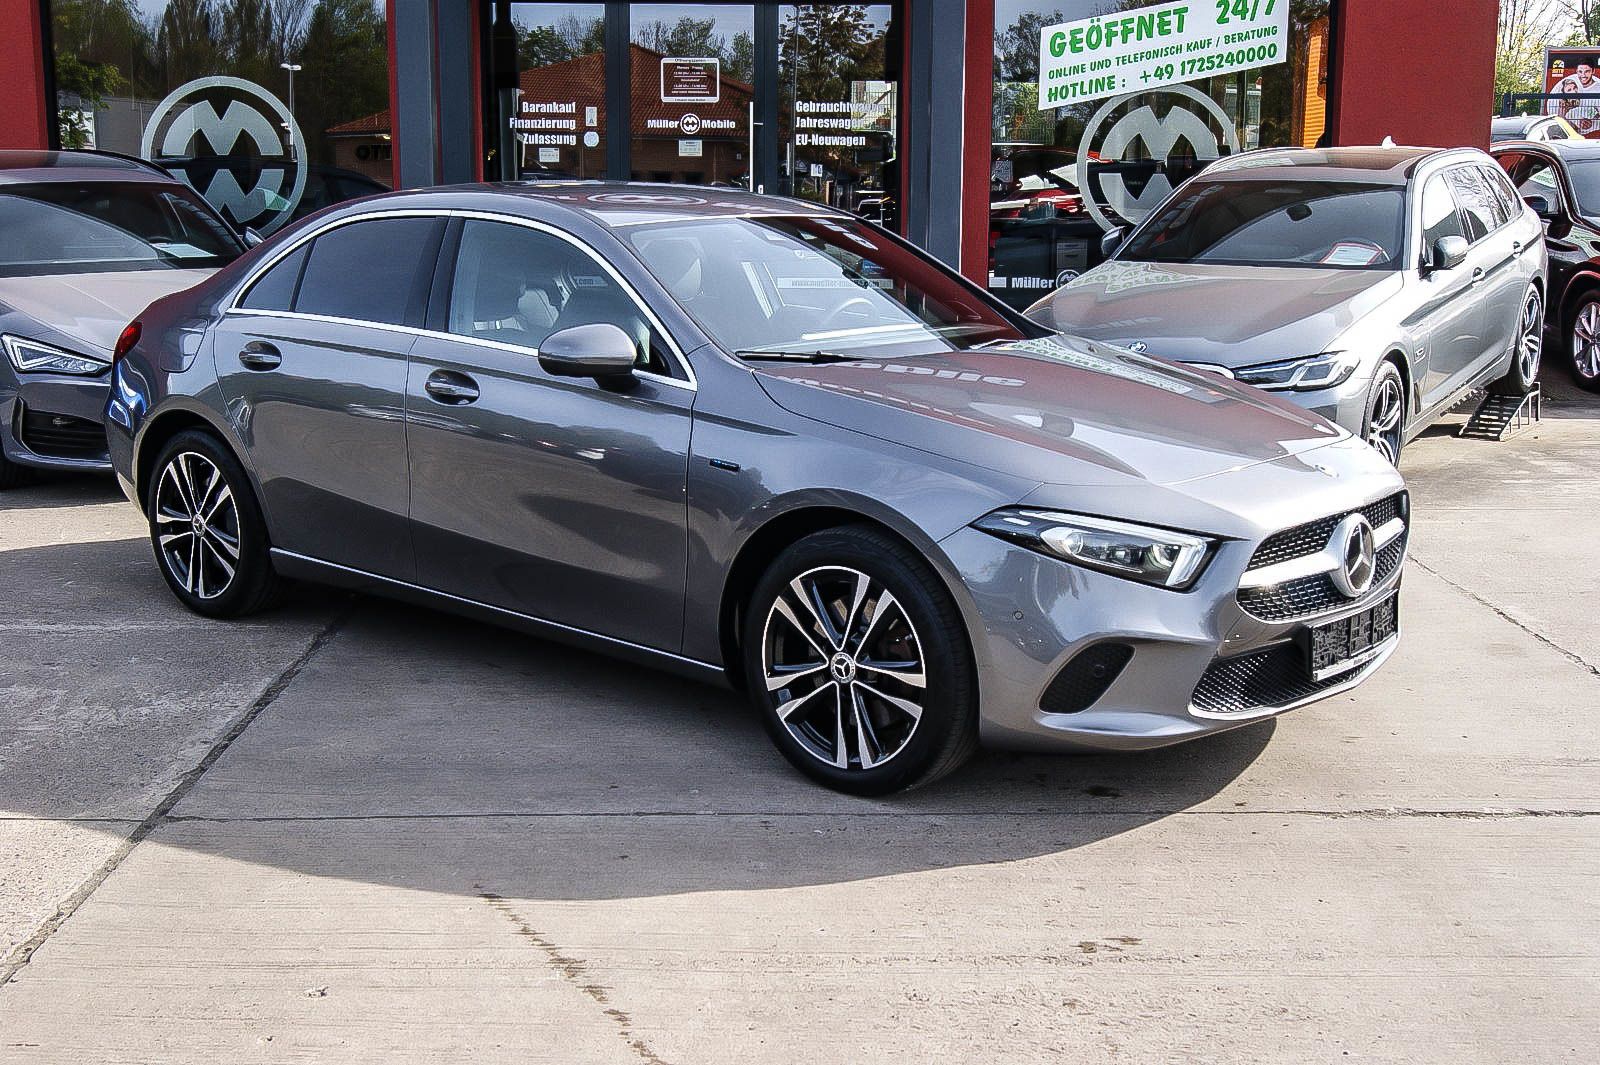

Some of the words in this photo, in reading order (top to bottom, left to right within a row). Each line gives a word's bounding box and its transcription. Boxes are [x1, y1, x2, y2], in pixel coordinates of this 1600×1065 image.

[1049, 6, 1189, 58] GEÖFFNET
[1048, 63, 1086, 80] ONLINE
[1090, 59, 1111, 75] UND
[1115, 41, 1183, 67] TELEFONISCH
[1186, 37, 1213, 53] KAUF
[1223, 25, 1278, 45] BERATUNG
[1048, 74, 1117, 103] HOTLINE
[1139, 63, 1174, 84] +49
[1180, 42, 1278, 76] 1725240000
[522, 101, 577, 113] Barankauf
[509, 117, 577, 131] Finanzierung
[647, 119, 680, 129] Müller
[701, 120, 736, 129] Mobile
[795, 117, 865, 130] Jahreswagen
[522, 132, 577, 146] Zulassung
[795, 134, 866, 147] EU-Neuwagen
[1011, 276, 1054, 289] Müller
